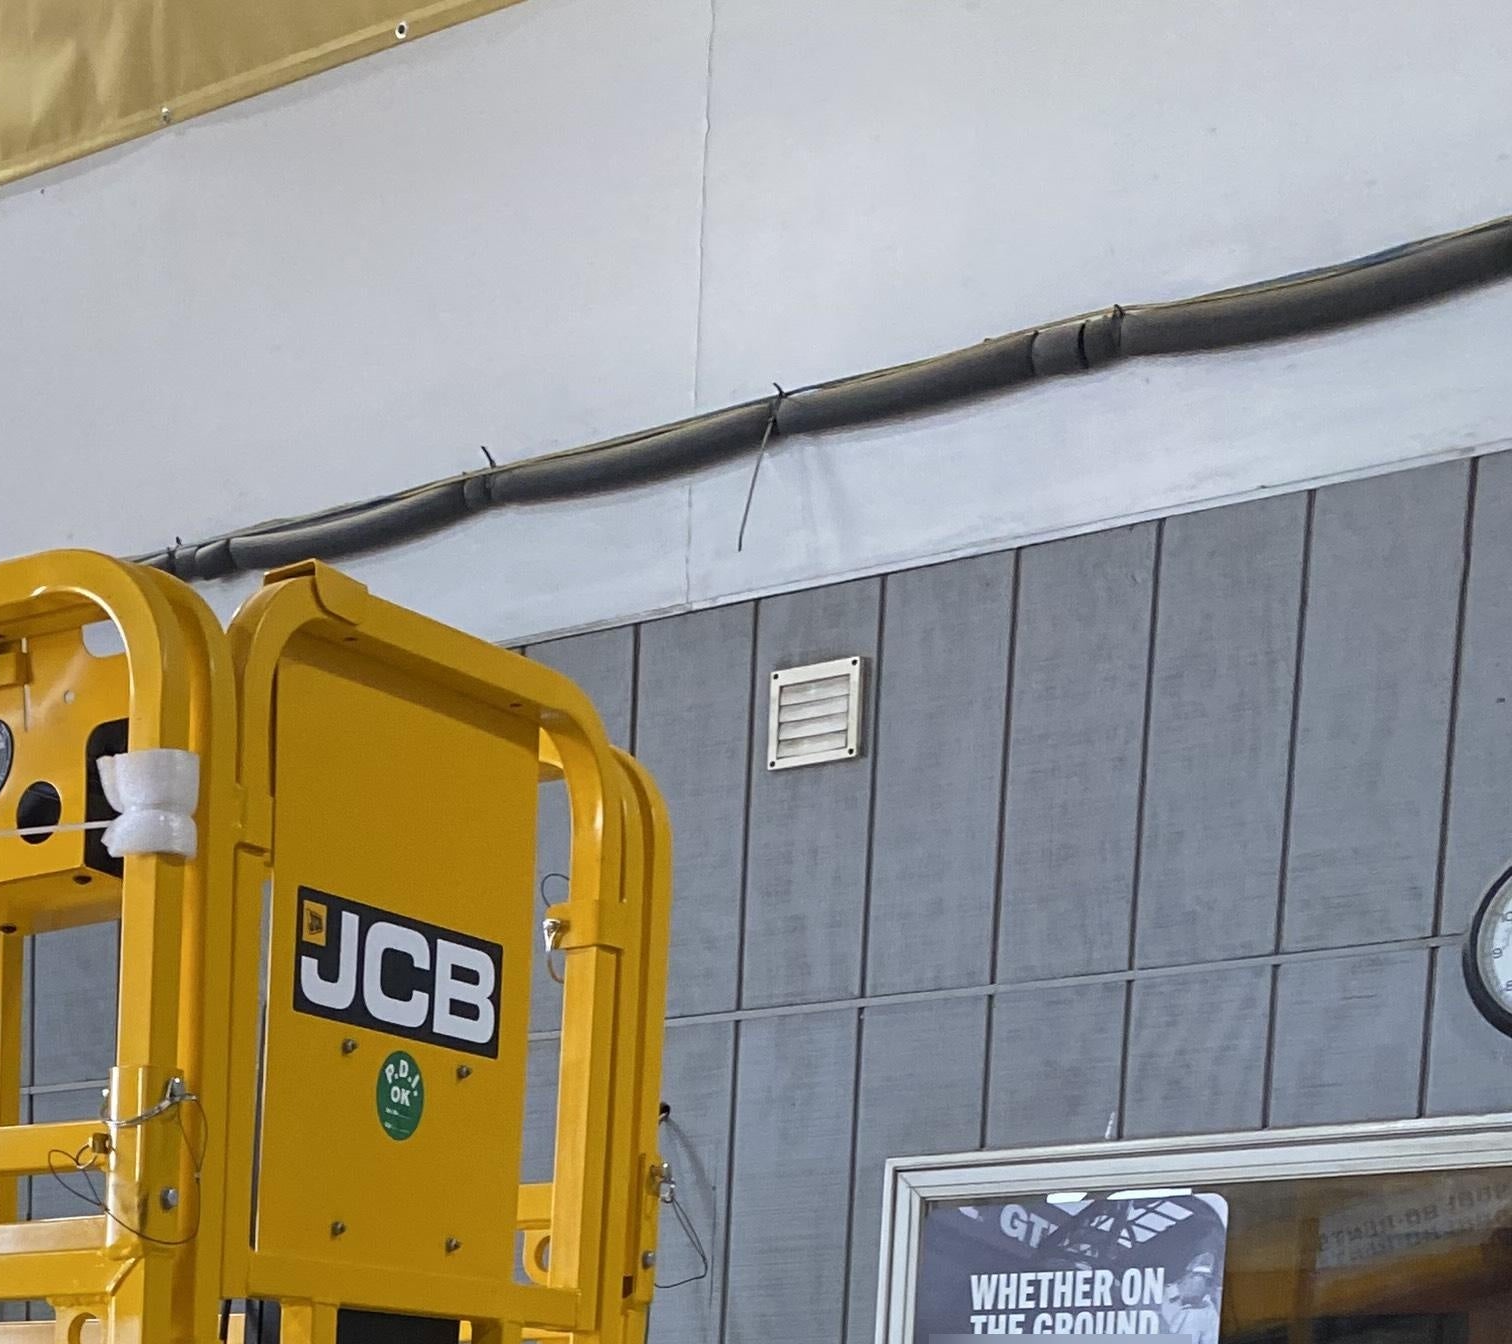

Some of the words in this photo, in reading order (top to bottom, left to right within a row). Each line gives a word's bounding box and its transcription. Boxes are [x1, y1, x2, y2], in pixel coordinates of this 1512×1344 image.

[1492, 947, 1503, 959] 9
[300, 910, 495, 1044] JCB
[391, 1086, 410, 1107] OK
[970, 1269, 1114, 1311] WHETHER
[1121, 1267, 1165, 1305] ON
